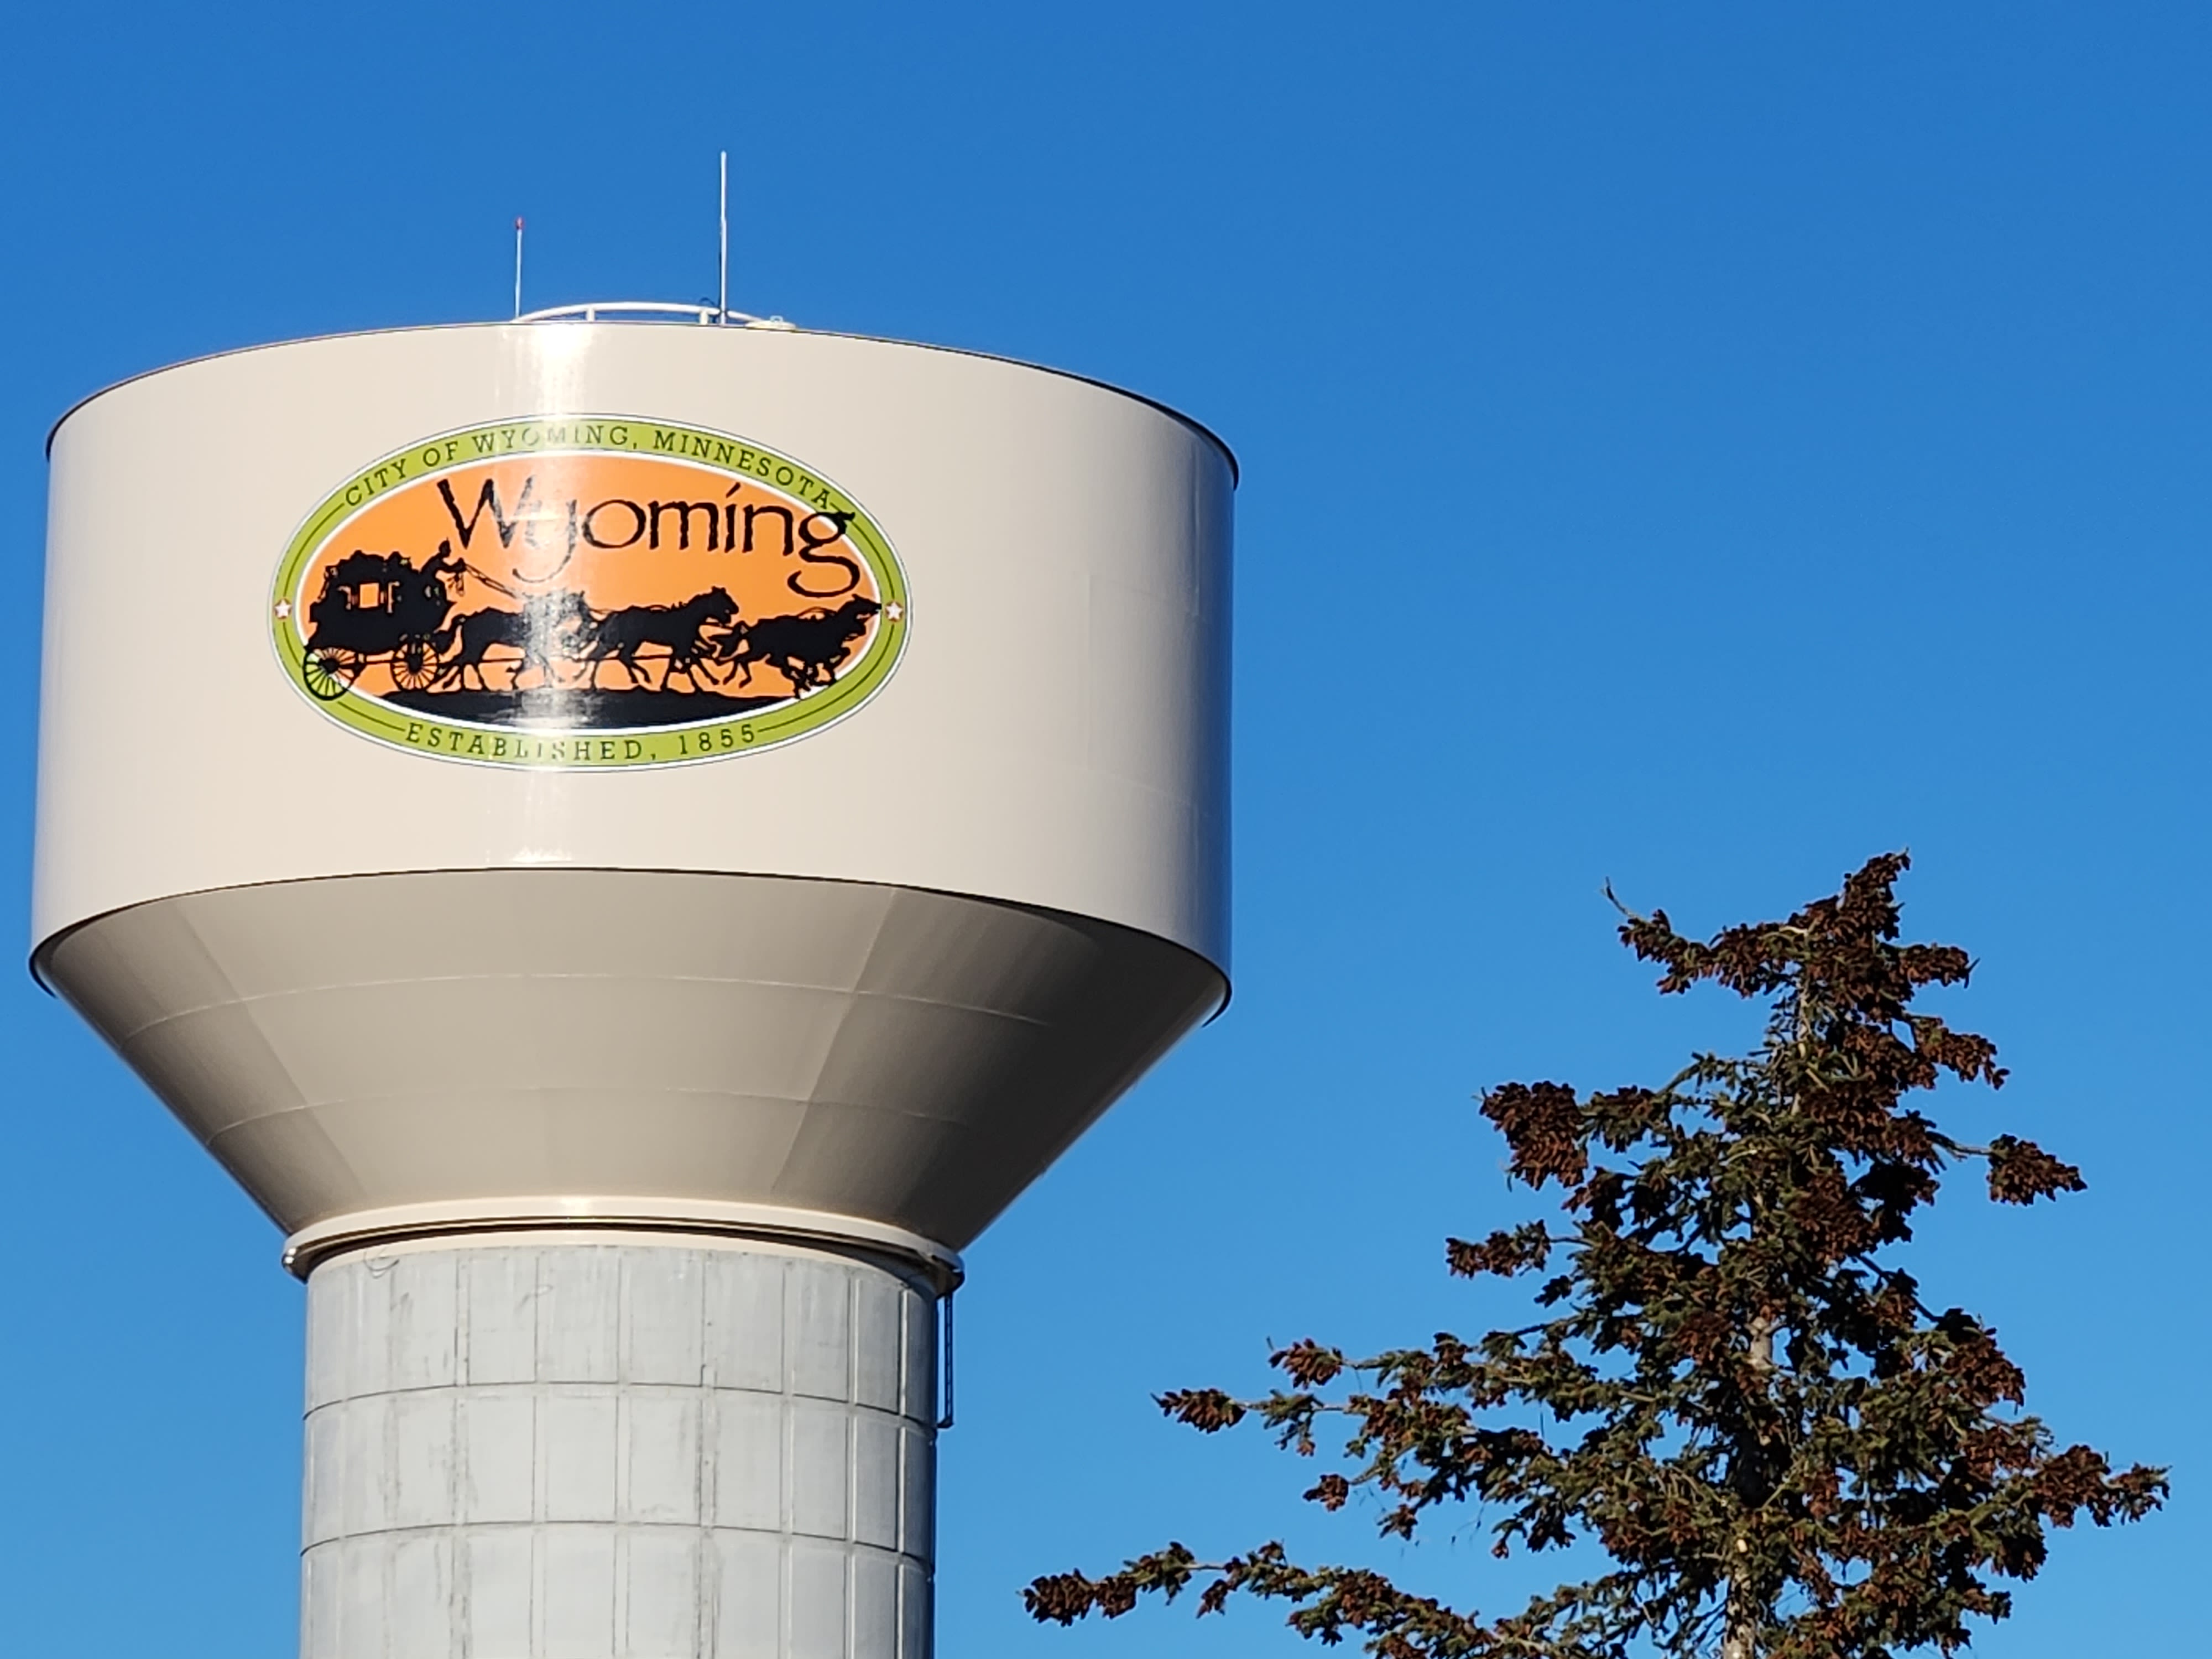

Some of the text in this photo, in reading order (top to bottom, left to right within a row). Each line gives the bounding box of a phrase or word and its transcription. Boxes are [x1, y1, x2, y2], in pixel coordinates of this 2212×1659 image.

[345, 425, 832, 509] CITY OF WYOMING, MINNESOTA
[405, 723, 755, 761] ESTABLISHED, 1855
